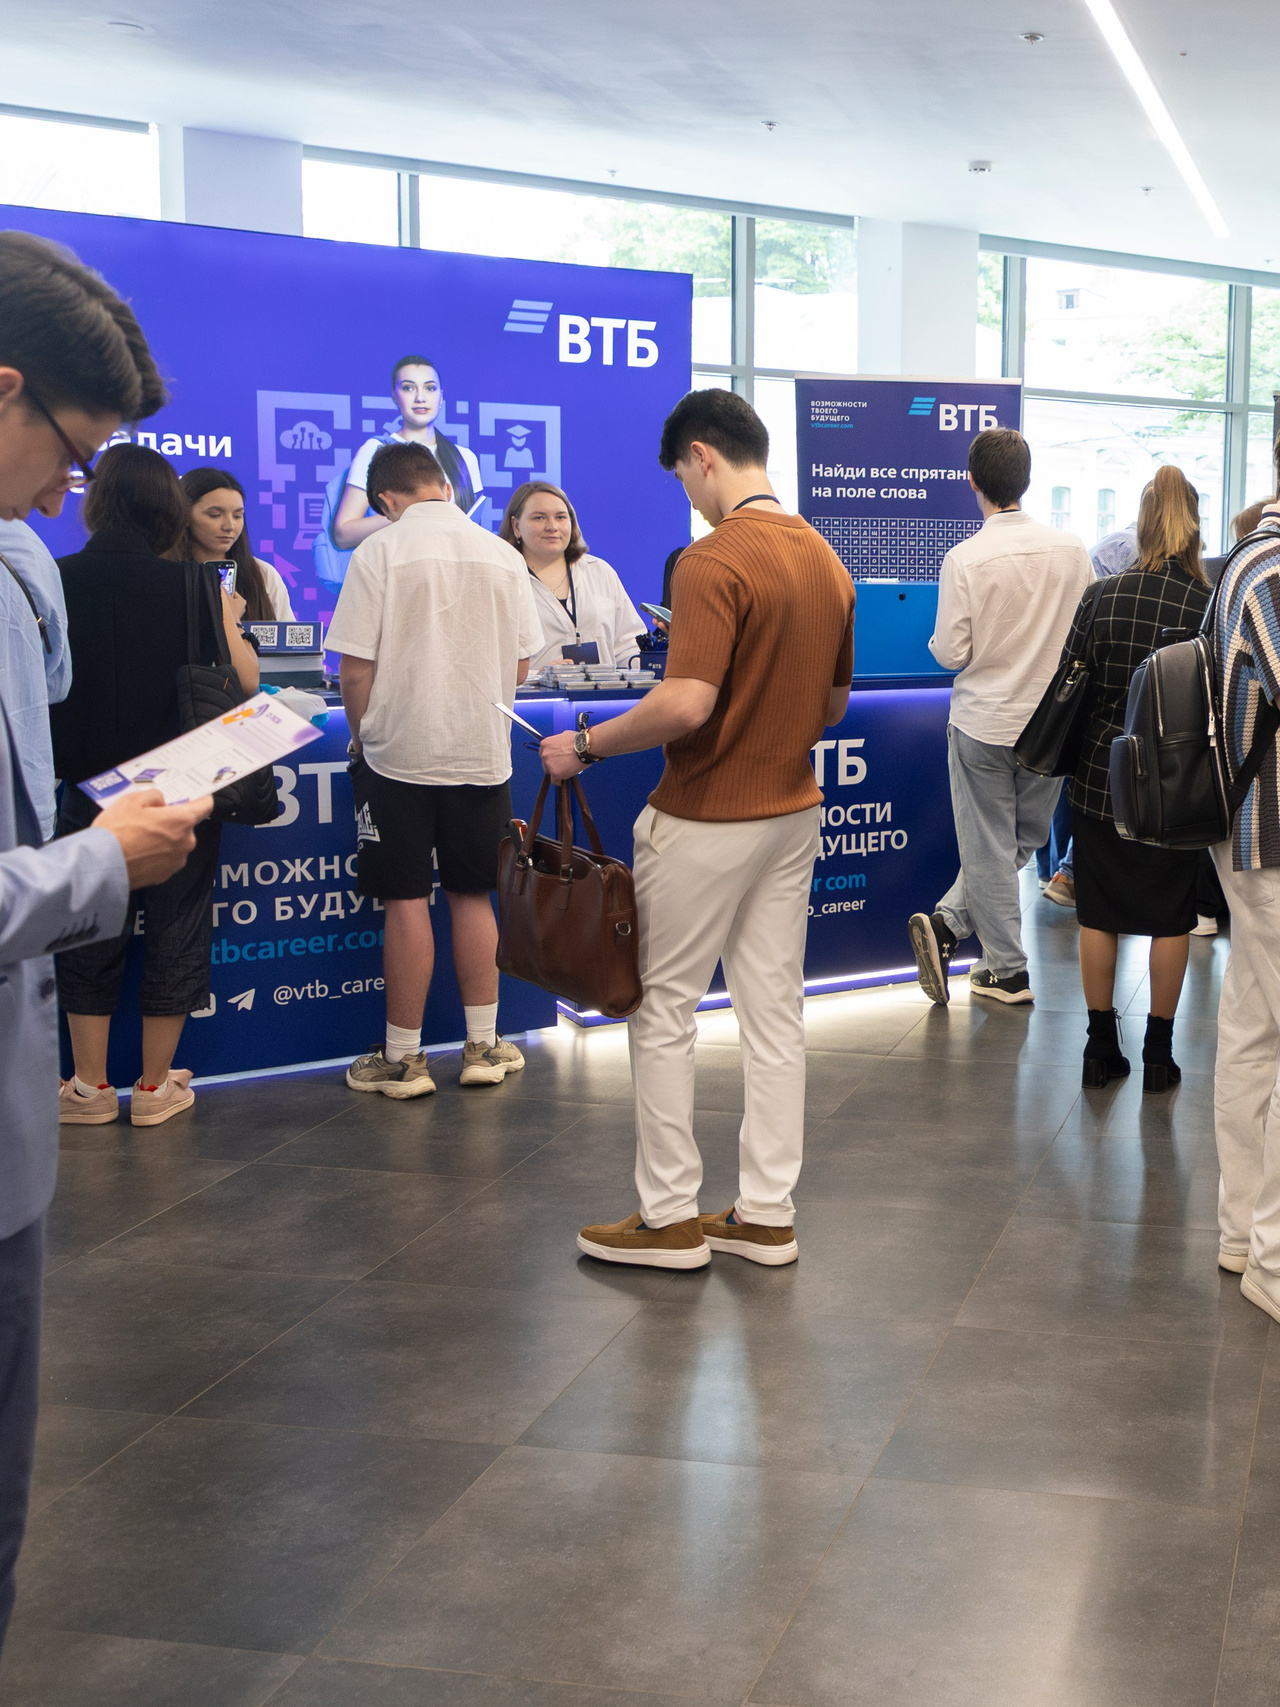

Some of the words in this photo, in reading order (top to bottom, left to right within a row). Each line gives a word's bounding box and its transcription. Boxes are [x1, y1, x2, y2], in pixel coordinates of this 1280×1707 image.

[558, 314, 659, 368] ВТБ
[810, 400, 868, 408] ВОЗМОЖНОСТИ
[939, 403, 999, 432] ВТБ
[97, 430, 232, 458] адачи
[811, 464, 866, 479] Найди
[870, 468, 897, 479] все
[900, 468, 971, 483] спрятан
[811, 486, 832, 497] на
[836, 486, 876, 498] поле
[879, 487, 927, 499] слова
[811, 738, 868, 788] ТБ
[254, 761, 350, 829] ВТ
[211, 929, 384, 966] tbcareer.co
[273, 976, 386, 1006] @vtb_care
